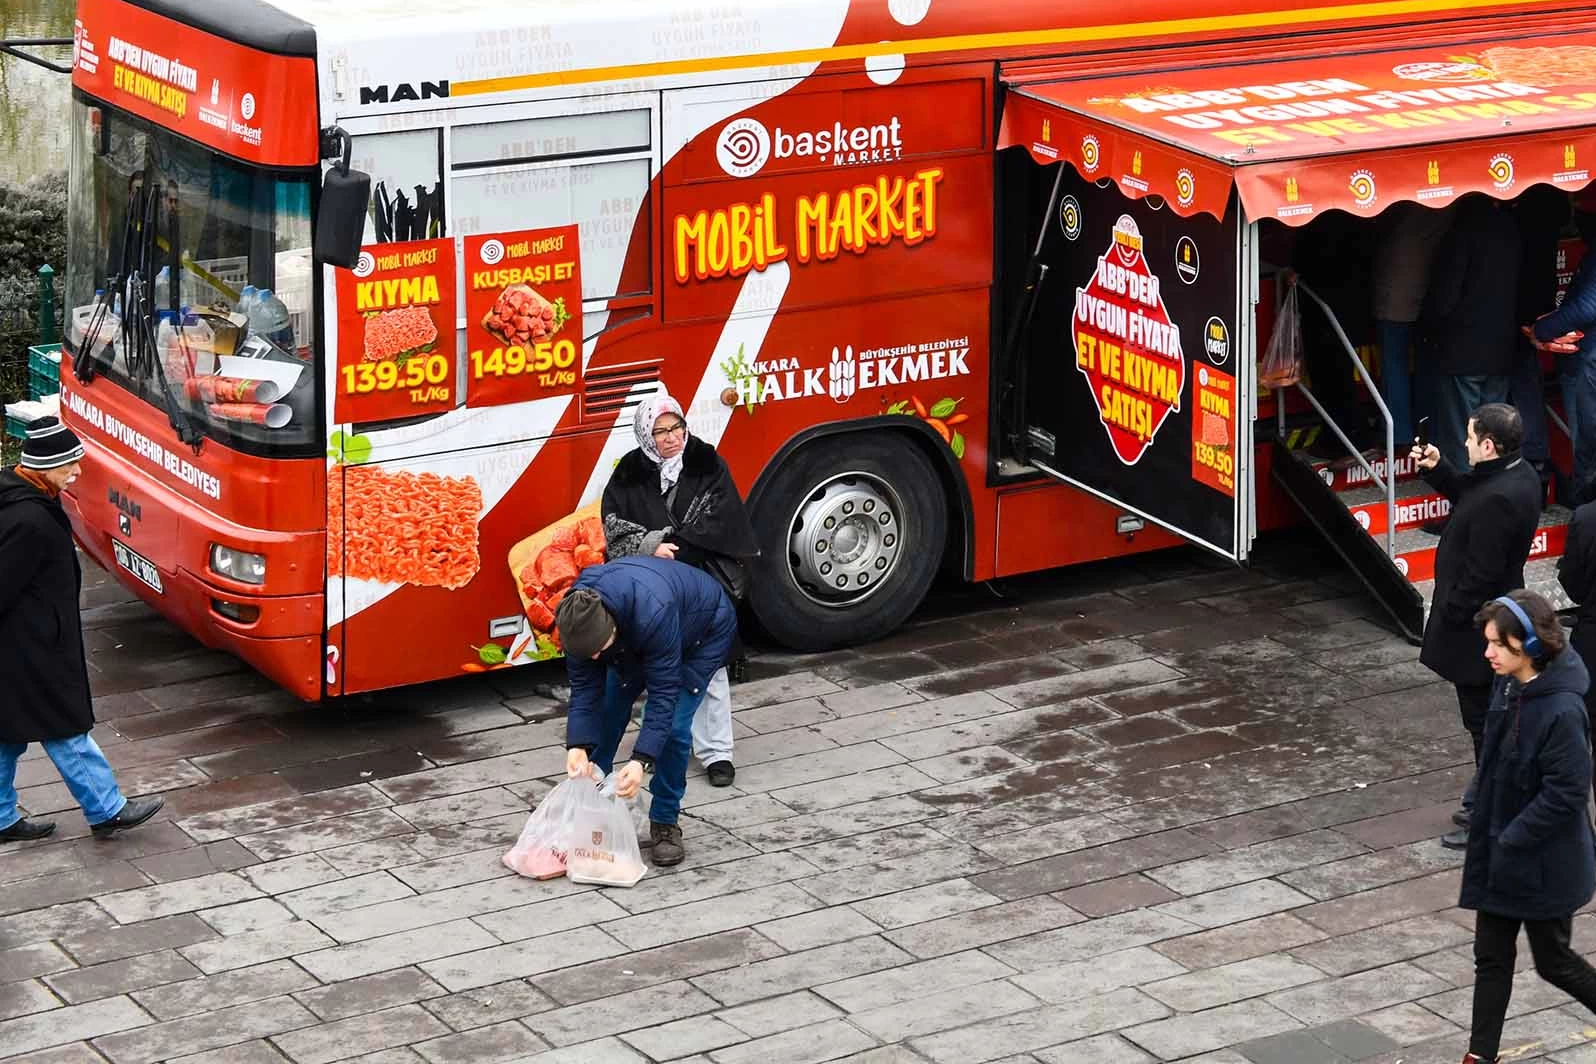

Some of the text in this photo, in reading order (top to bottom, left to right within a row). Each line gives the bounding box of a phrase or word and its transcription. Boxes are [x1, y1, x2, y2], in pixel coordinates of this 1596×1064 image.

[108, 36, 141, 69] ABB'DEN
[141, 49, 169, 81] UYGUN
[169, 58, 197, 93] FİYATA
[114, 65, 123, 87] ET
[124, 70, 135, 93] VE
[135, 74, 160, 104] KIYMA
[360, 79, 449, 105] MAN
[1121, 78, 1370, 113] ABB'DEN
[1163, 81, 1550, 130] UYGUN FİYATA
[1211, 123, 1296, 148] ET
[1283, 117, 1382, 138] VE
[1364, 94, 1559, 129] KIYMA
[774, 116, 902, 162] başkent
[833, 147, 902, 166] MARKET
[674, 167, 943, 281] MOBİL MARKET
[403, 248, 437, 268] MARKET
[533, 236, 564, 255] MARKET
[356, 275, 440, 312] KIYMA
[473, 262, 575, 290] KUŞBAŞI ET
[1097, 259, 1159, 308] ABB'DEN
[1077, 290, 1180, 360] UYGUN FİYATA
[471, 340, 575, 380] 149.50
[737, 357, 800, 377] ANKARA
[859, 336, 969, 361] BÜYÜKŞEHİR BELEDİYESİ
[341, 354, 449, 394] 139.50
[538, 371, 576, 388] TL/Kg
[735, 347, 971, 406] HALK EKMEK
[1078, 331, 1179, 406] ET VE KIYMA
[70, 391, 104, 430] ANKARA
[409, 388, 449, 404] TL/Kg
[1101, 385, 1153, 441] SATIŞI
[1200, 388, 1230, 420] KIYMA
[1194, 440, 1233, 476] 139.50
[108, 488, 142, 522] MAN
[1394, 497, 1451, 525] ÜRETİCİD
